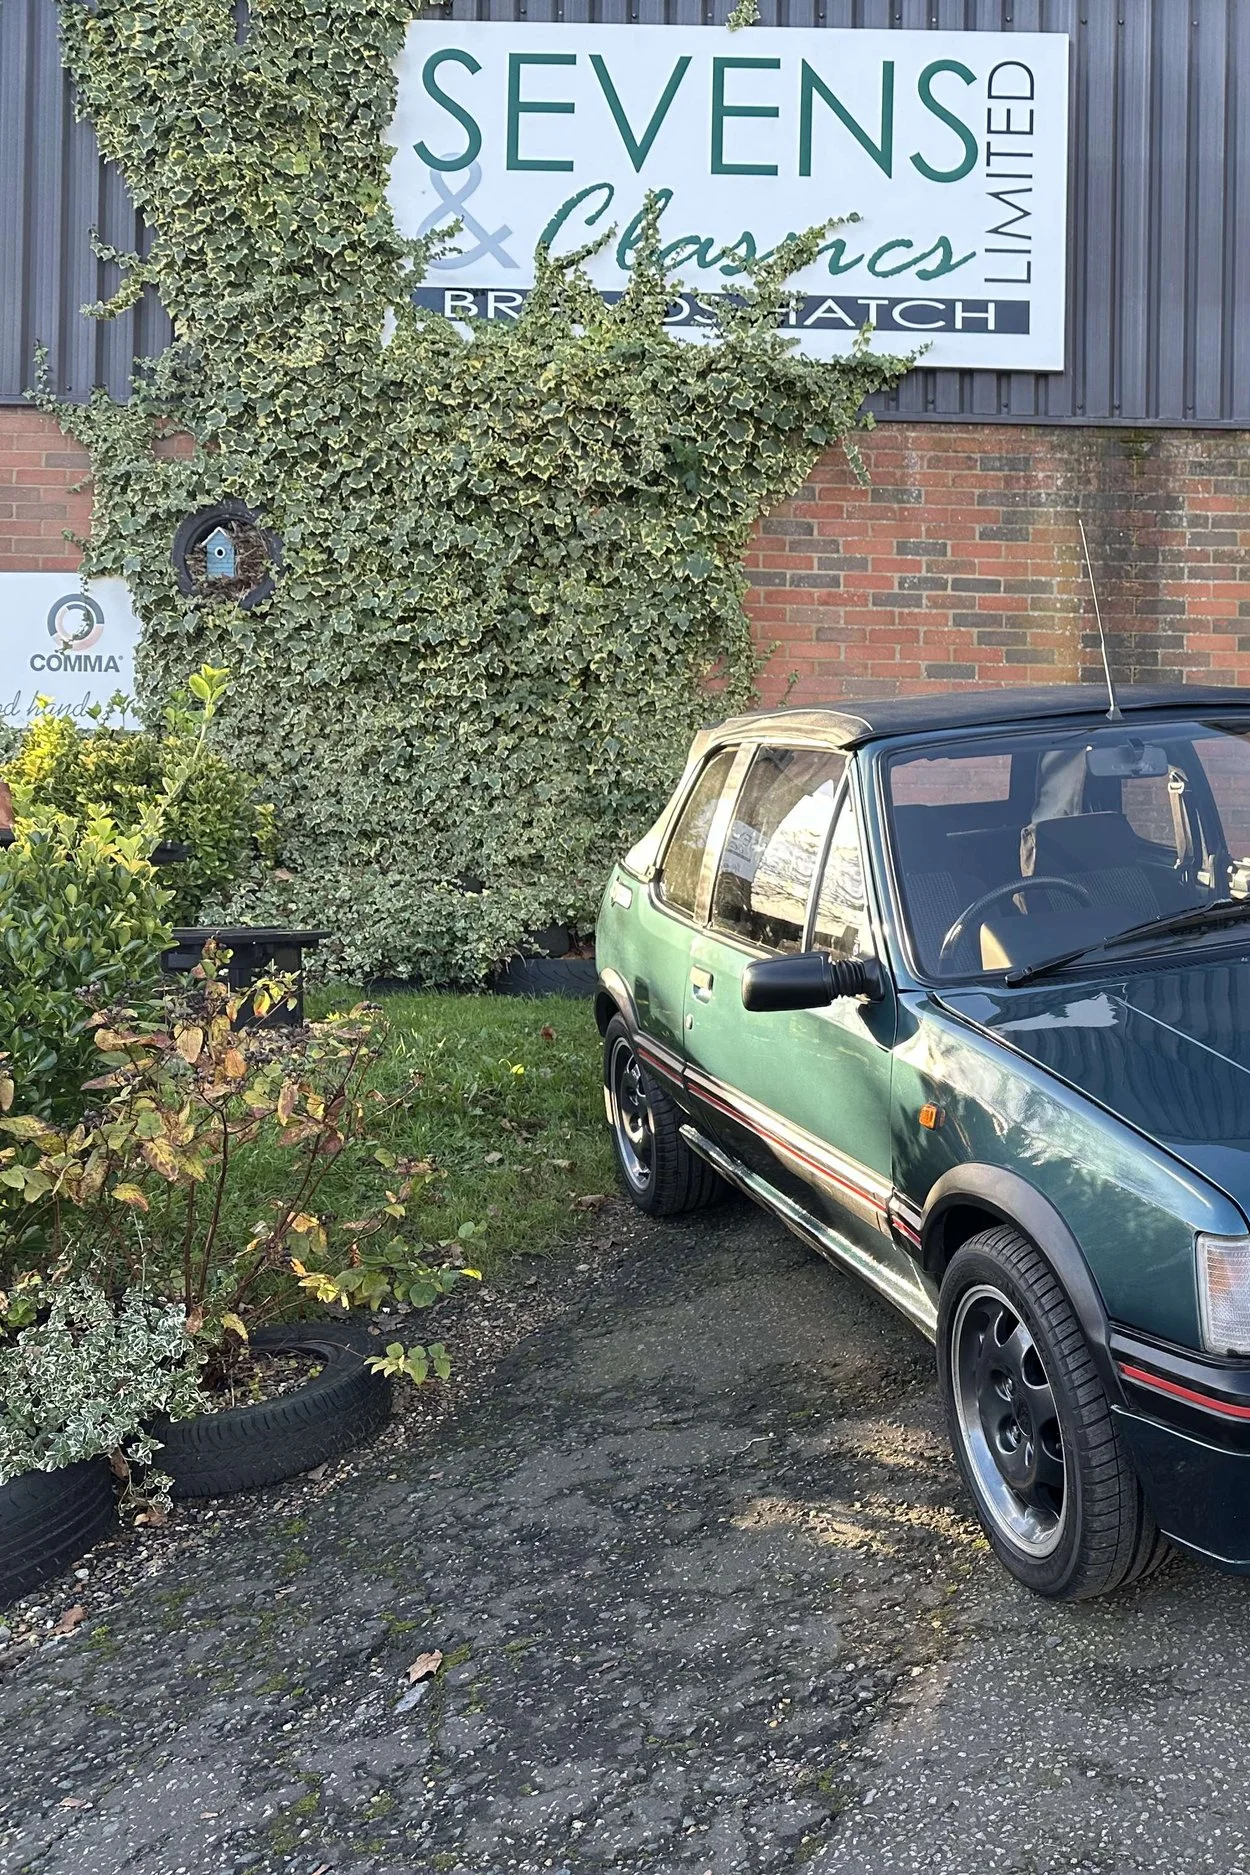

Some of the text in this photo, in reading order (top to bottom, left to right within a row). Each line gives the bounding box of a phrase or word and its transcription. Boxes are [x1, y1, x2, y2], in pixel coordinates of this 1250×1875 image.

[412, 48, 979, 184] SEVENS
[984, 60, 1035, 284] LIMITED
[416, 153, 977, 282] & Clasics
[26, 690, 93, 717] hand
[29, 653, 121, 673] COMMA
